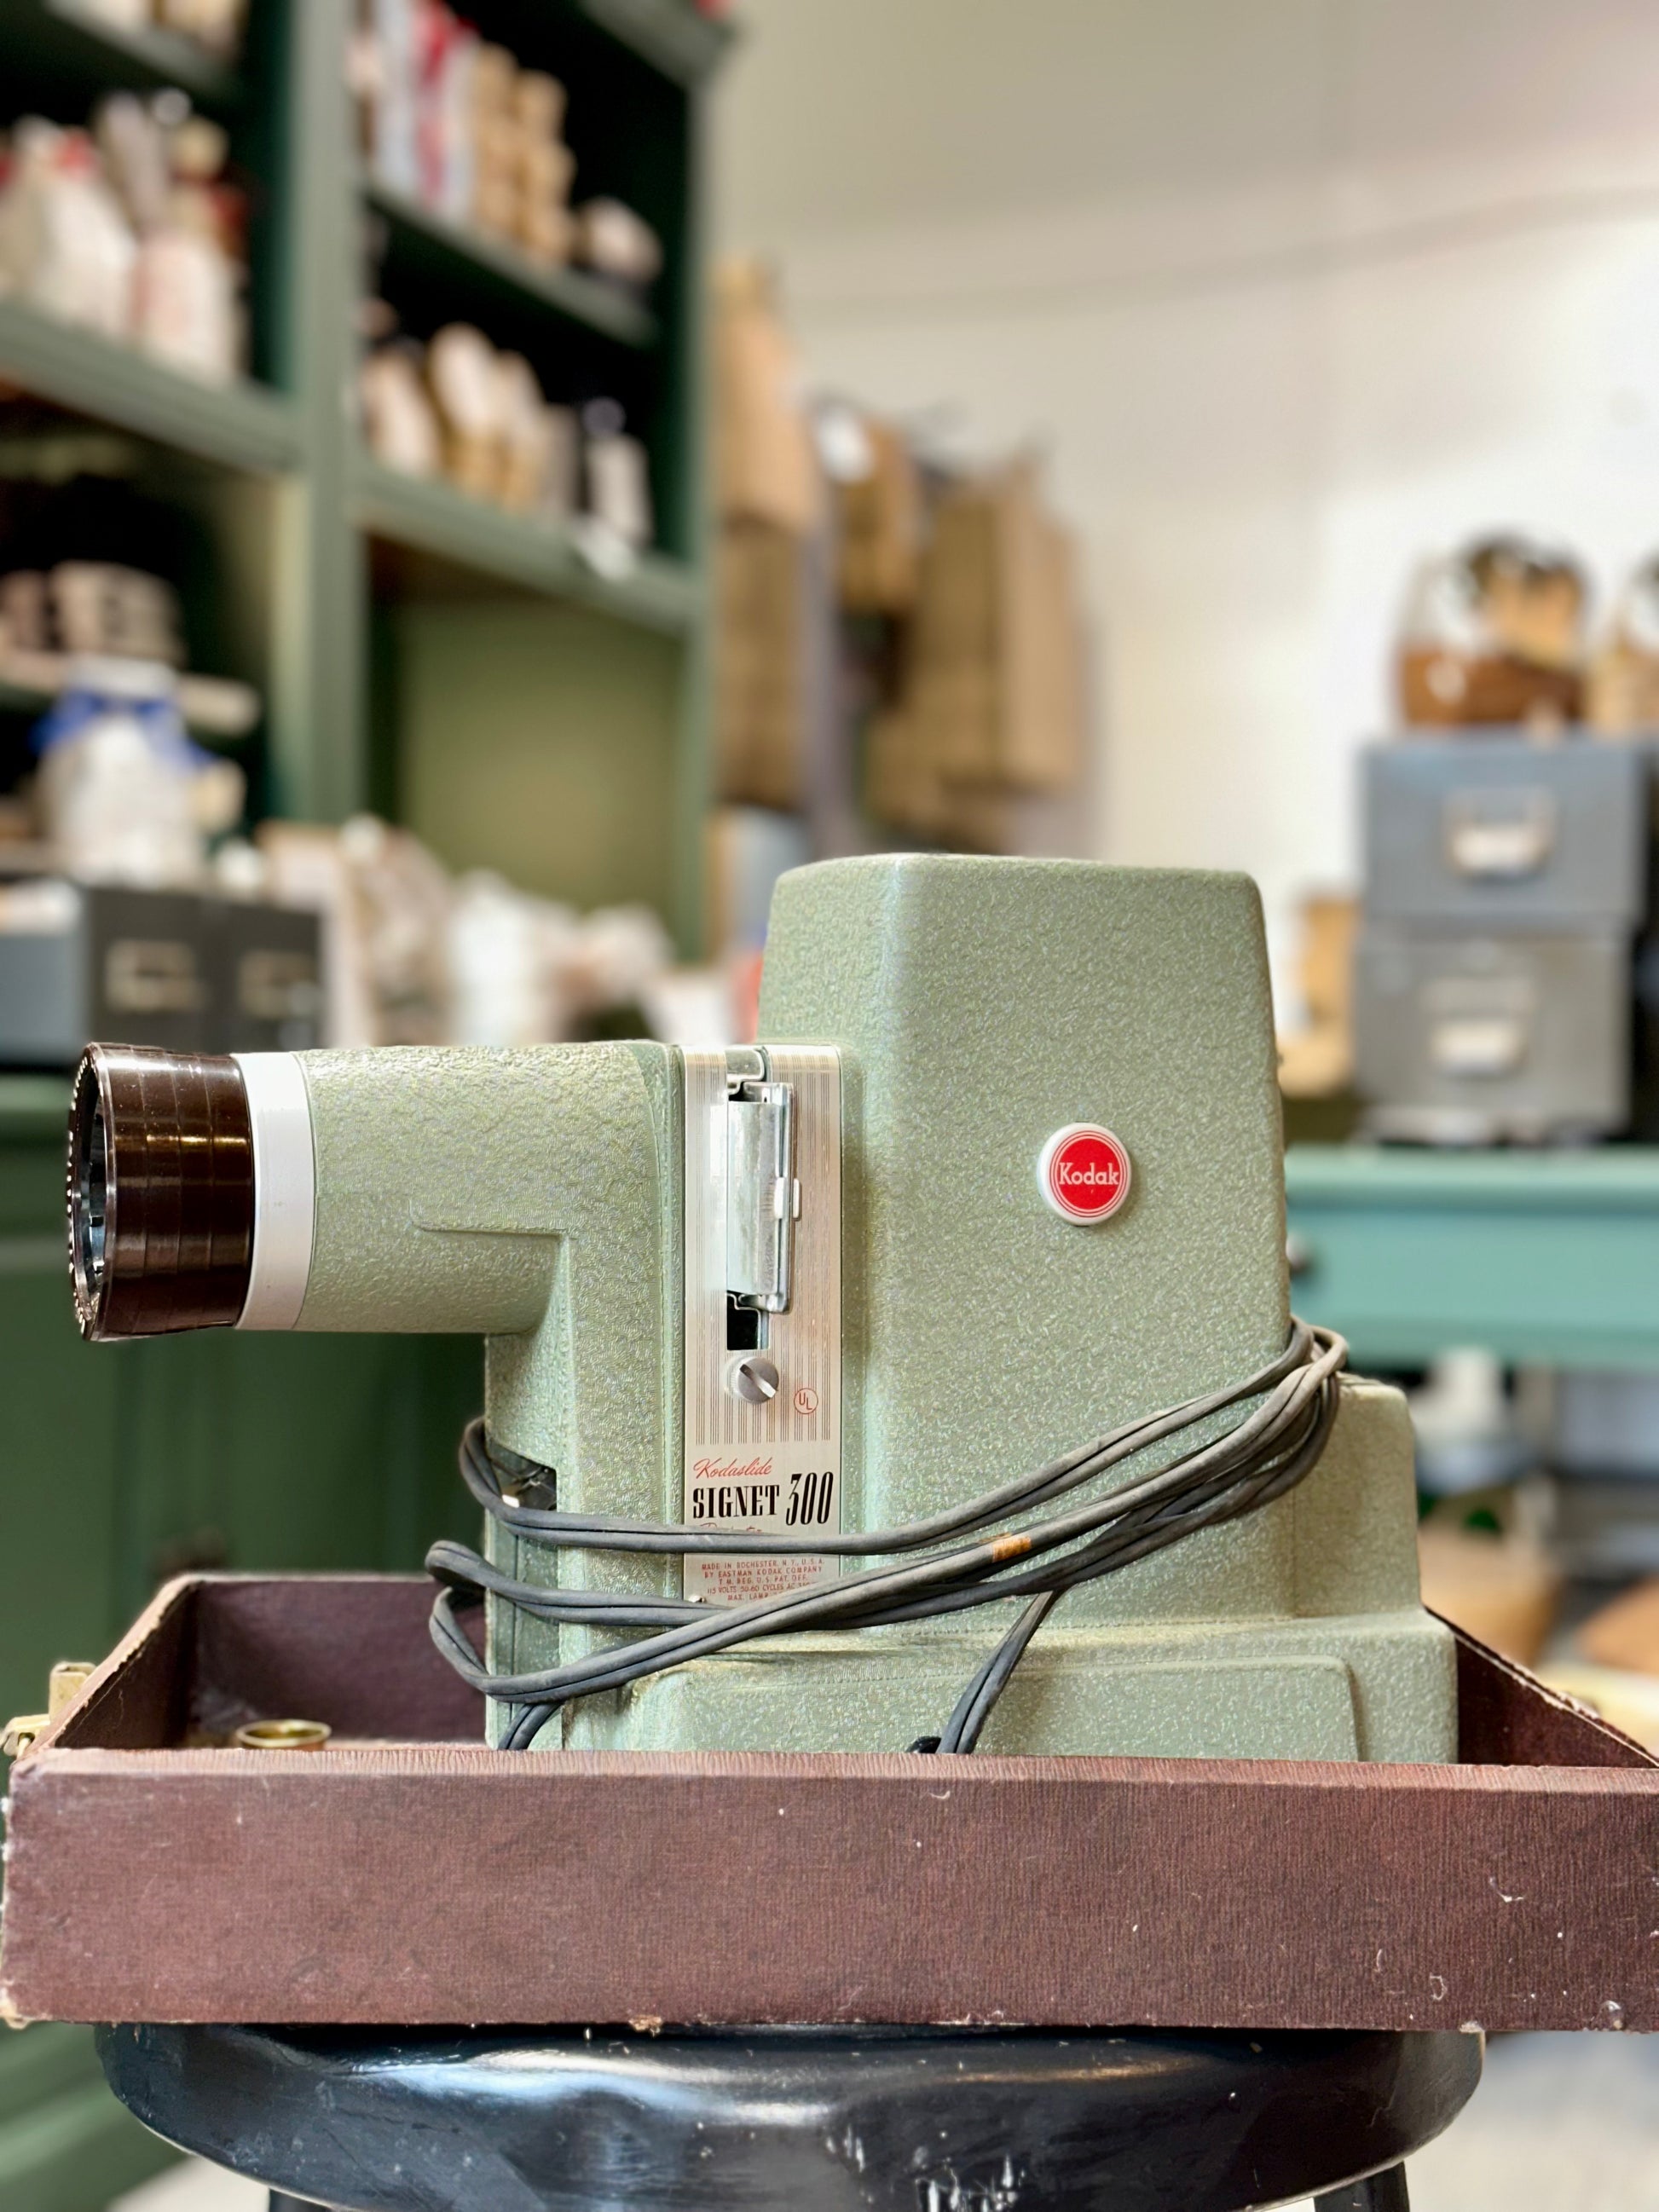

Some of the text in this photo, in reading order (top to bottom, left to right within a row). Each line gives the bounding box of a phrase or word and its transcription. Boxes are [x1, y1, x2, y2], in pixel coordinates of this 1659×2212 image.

[1058, 1162, 1119, 1186] Kodak
[799, 1392, 812, 1411] UL
[692, 1457, 773, 1479] Kodaslide
[692, 1471, 834, 1526] SIGNET 300
[718, 1569, 752, 1578] EASTMAN
[786, 1566, 822, 1574] COMPANY
[708, 1586, 716, 1595] 115
[749, 1592, 769, 1601] LAMP
